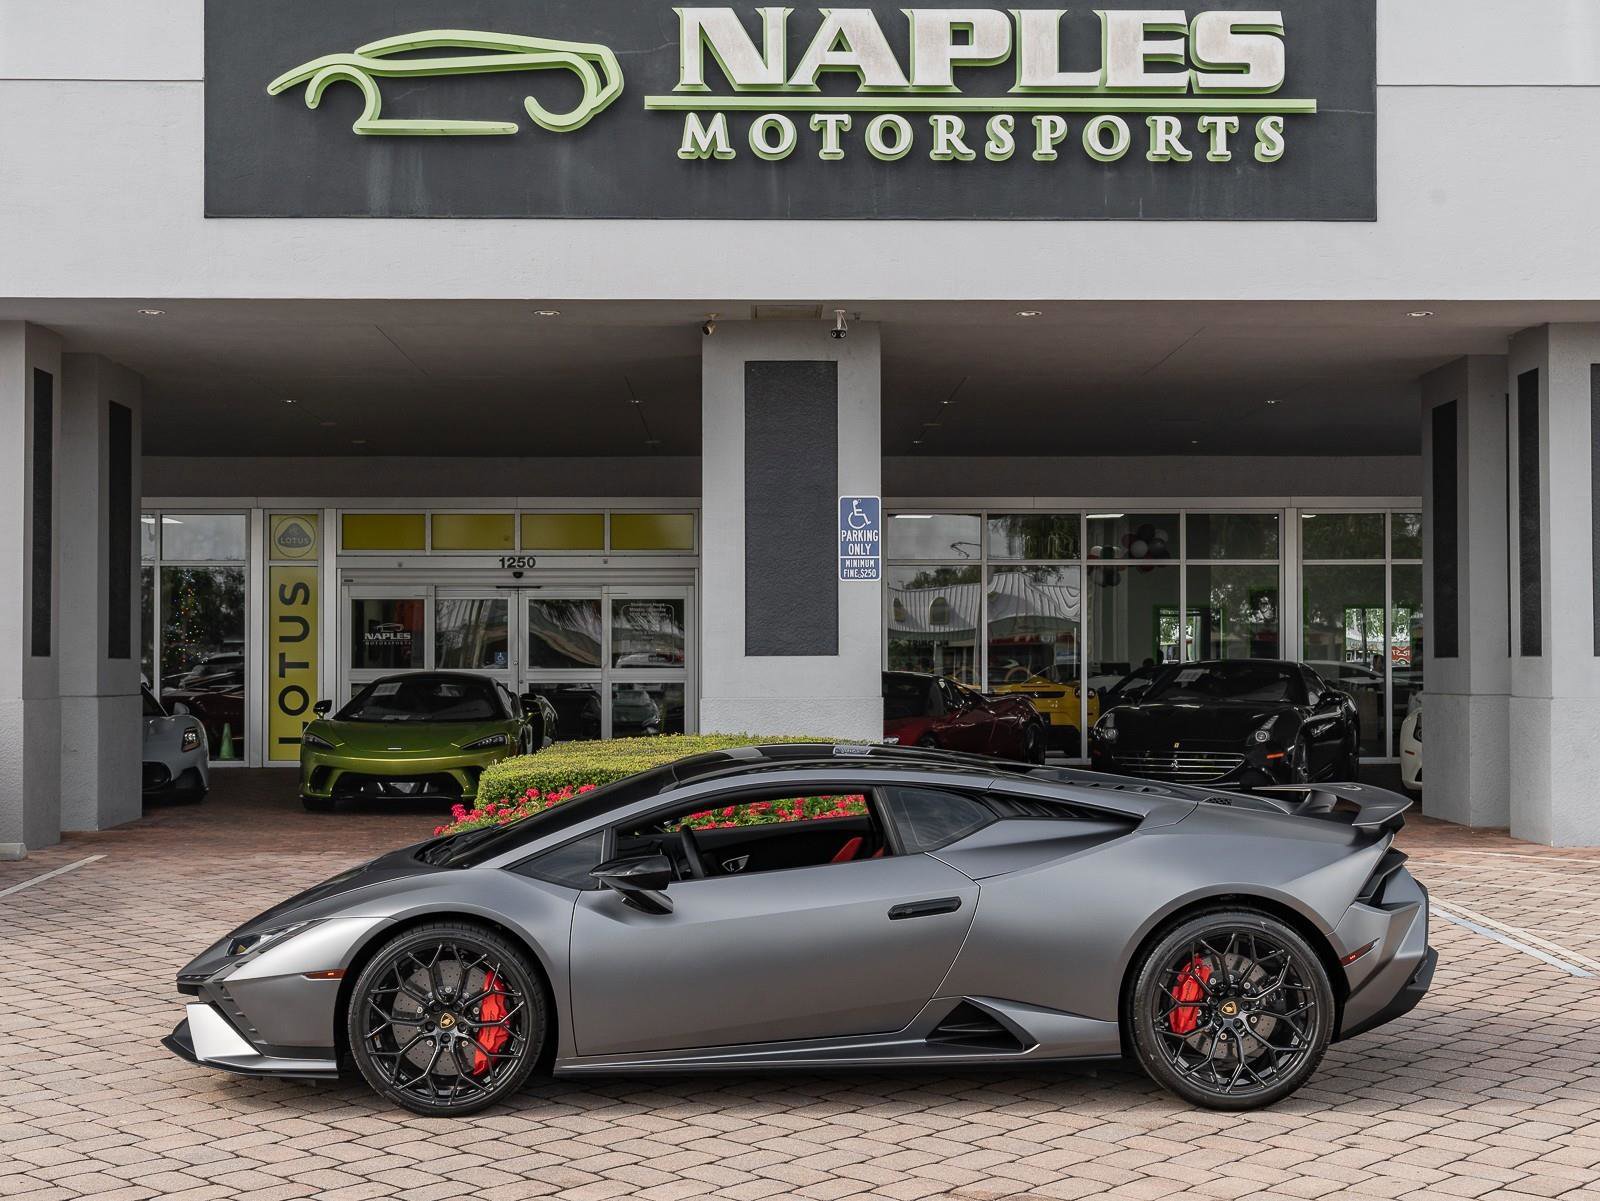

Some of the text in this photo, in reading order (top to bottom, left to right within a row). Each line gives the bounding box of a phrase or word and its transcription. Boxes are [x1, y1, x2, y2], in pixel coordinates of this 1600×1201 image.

[673, 7, 1286, 94] NAPLES
[677, 112, 1286, 162] MOTORSPORTS
[280, 536, 310, 545] LOTUS
[841, 530, 879, 542] PARKING
[848, 543, 872, 556] ONLY
[499, 556, 536, 569] 1250
[845, 559, 875, 568] MINIMUM
[843, 568, 877, 578] FINE $250
[364, 632, 411, 640] NAPLES
